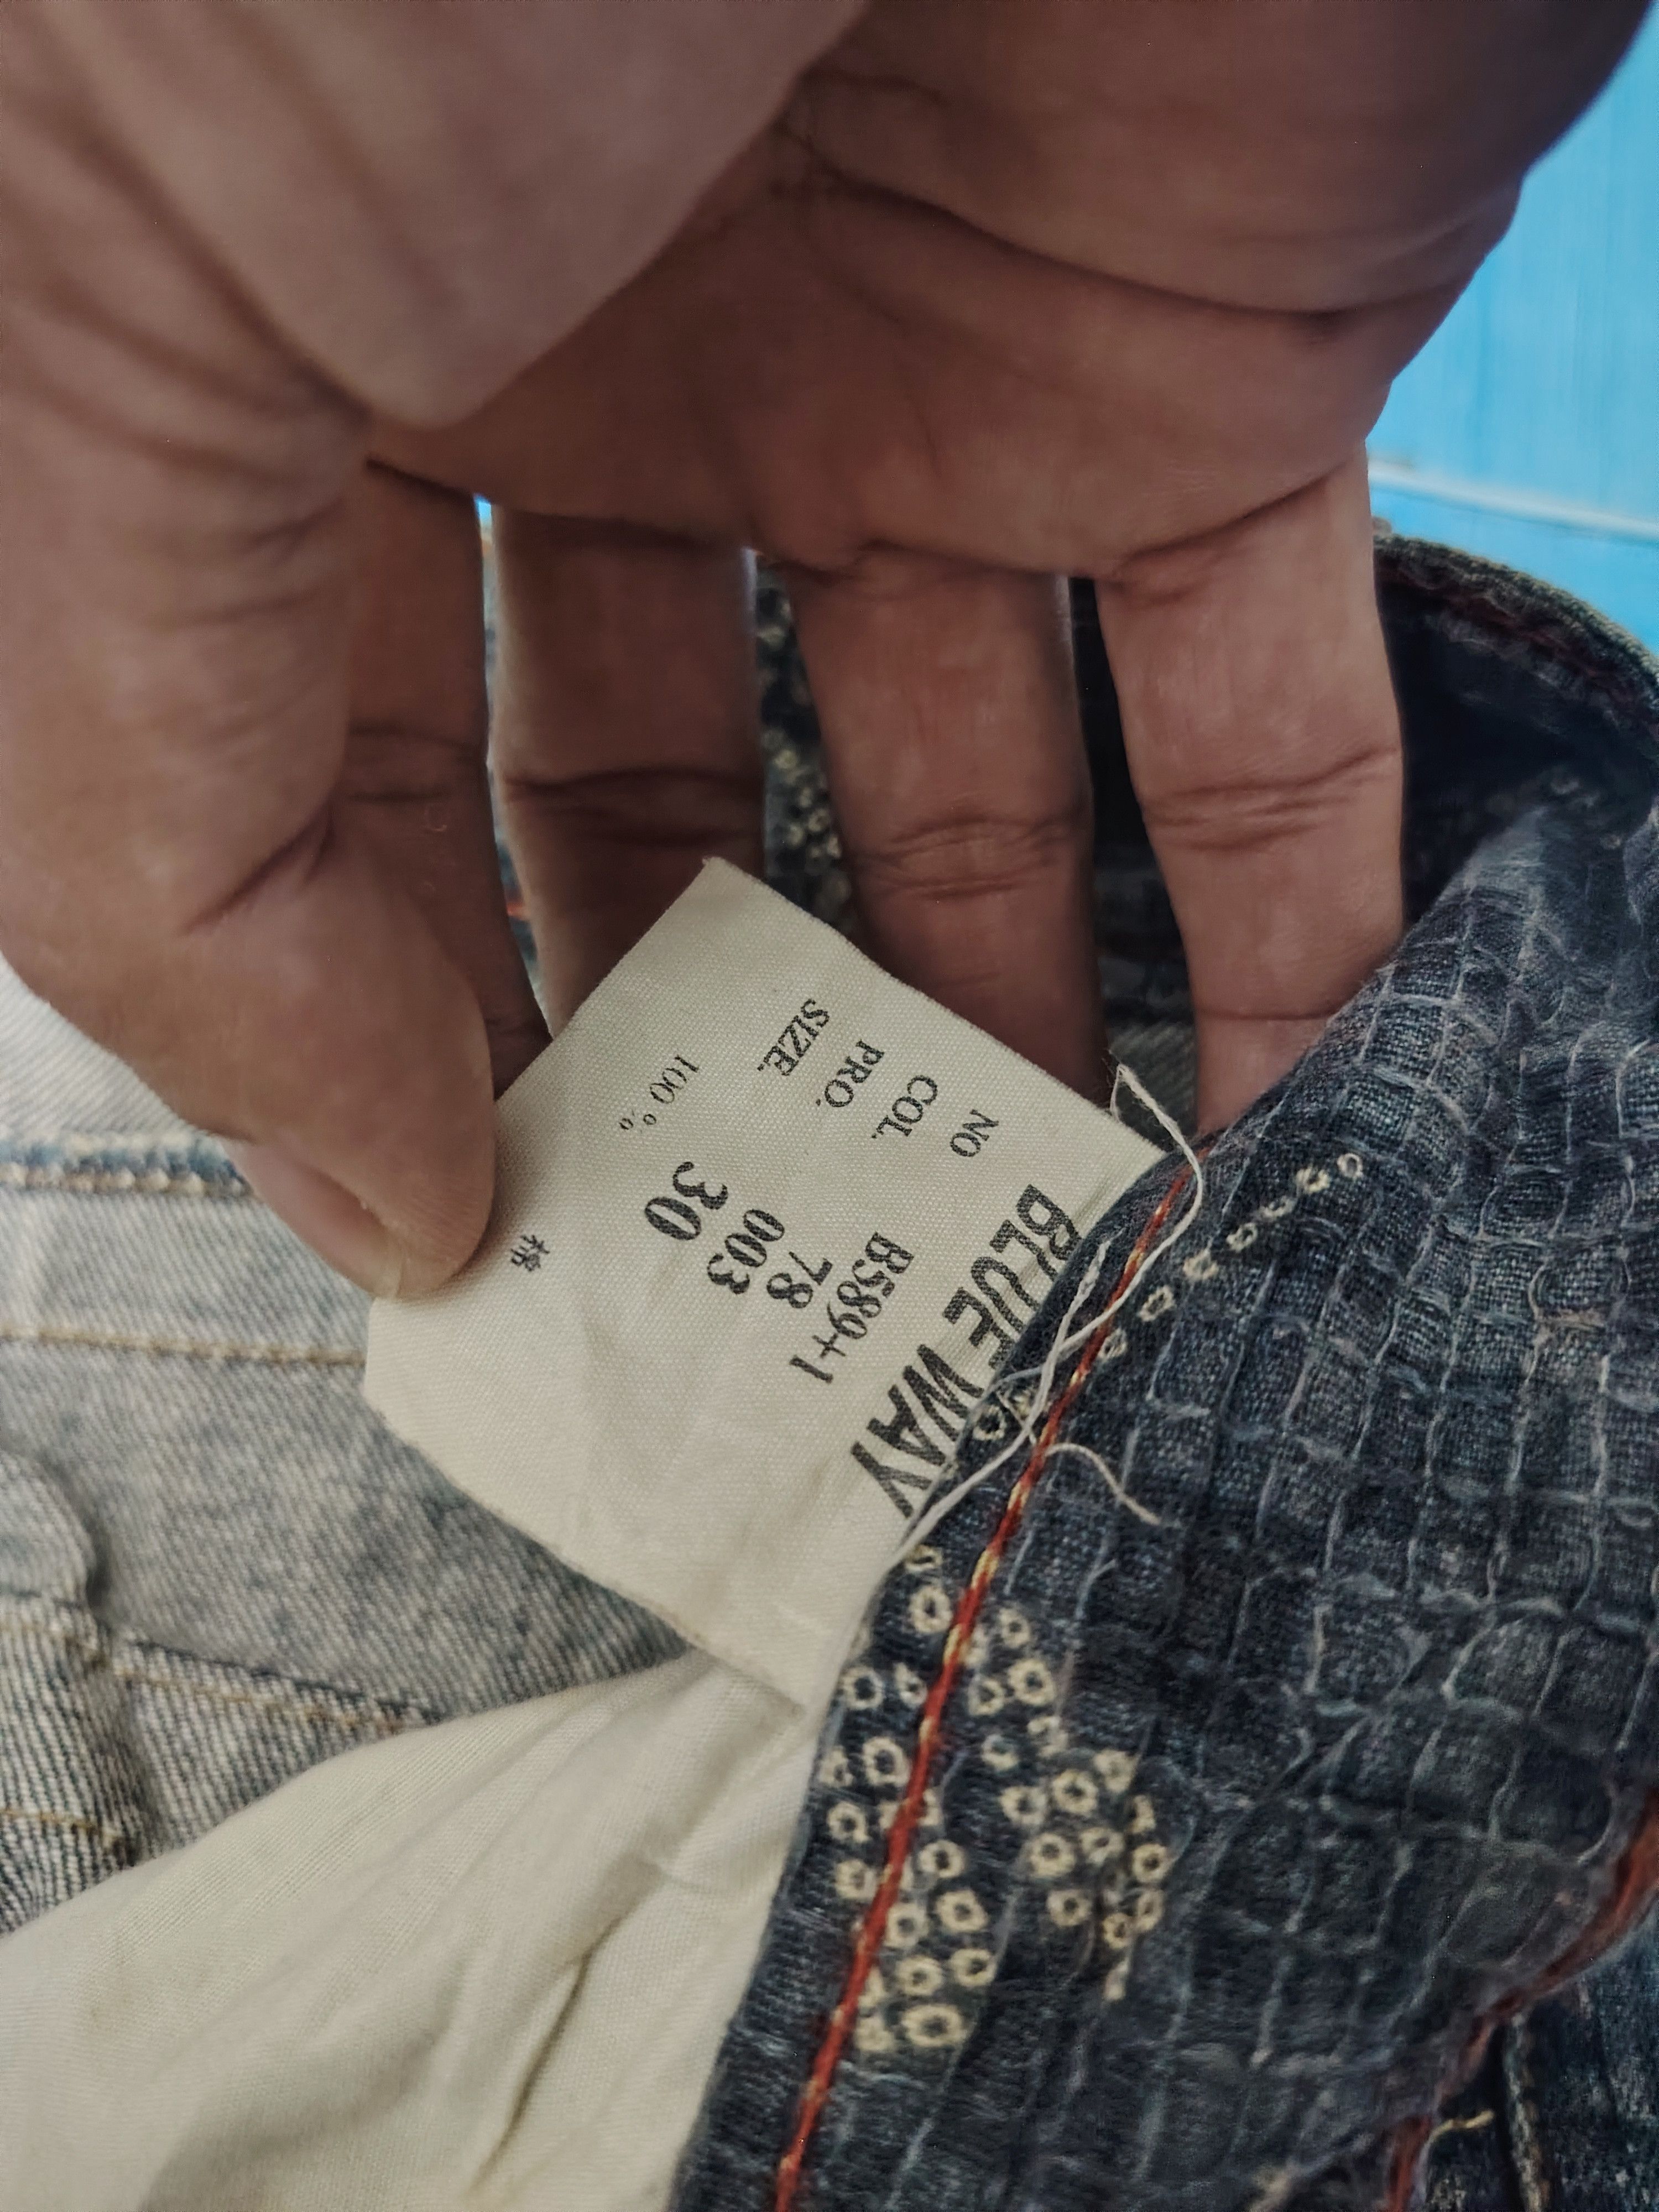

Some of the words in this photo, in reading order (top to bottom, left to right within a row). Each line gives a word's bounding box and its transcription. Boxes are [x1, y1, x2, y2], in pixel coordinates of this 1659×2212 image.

[756, 998, 831, 1078] SIZE.
[815, 1039, 885, 1109] PRO.
[870, 1074, 939, 1140] COL.
[949, 1108, 999, 1158] NO
[643, 1160, 729, 1241] 30
[706, 1208, 786, 1296] 003
[765, 1251, 834, 1310] 78
[943, 1183, 1081, 1367] BLUE
[788, 1232, 915, 1385] B589+1
[852, 1344, 983, 1520] WAY
